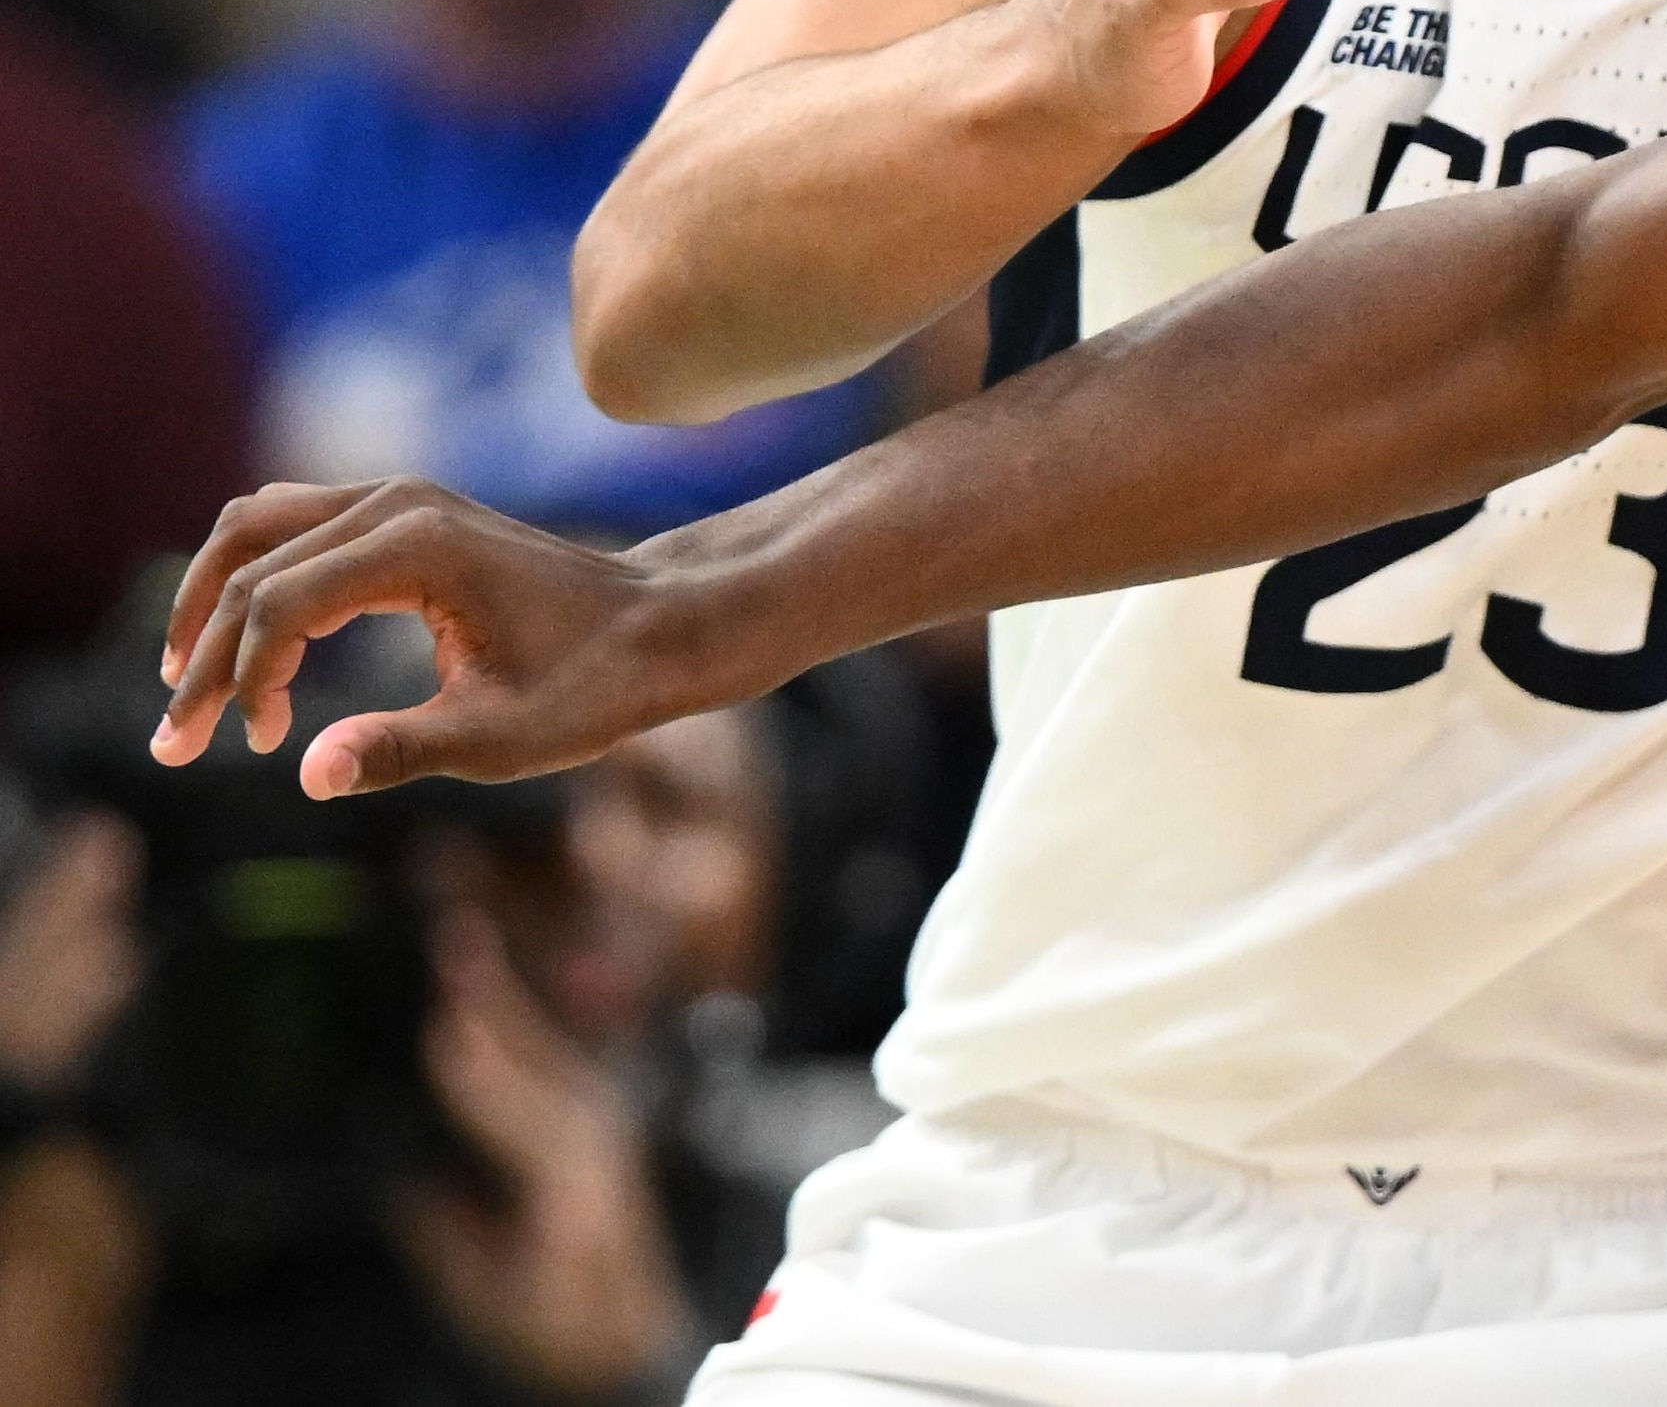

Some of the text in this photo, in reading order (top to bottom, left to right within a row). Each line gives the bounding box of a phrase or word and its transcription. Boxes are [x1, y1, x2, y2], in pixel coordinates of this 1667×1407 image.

[1351, 4, 1450, 43] BE TH
[1330, 34, 1447, 78] CHANG
